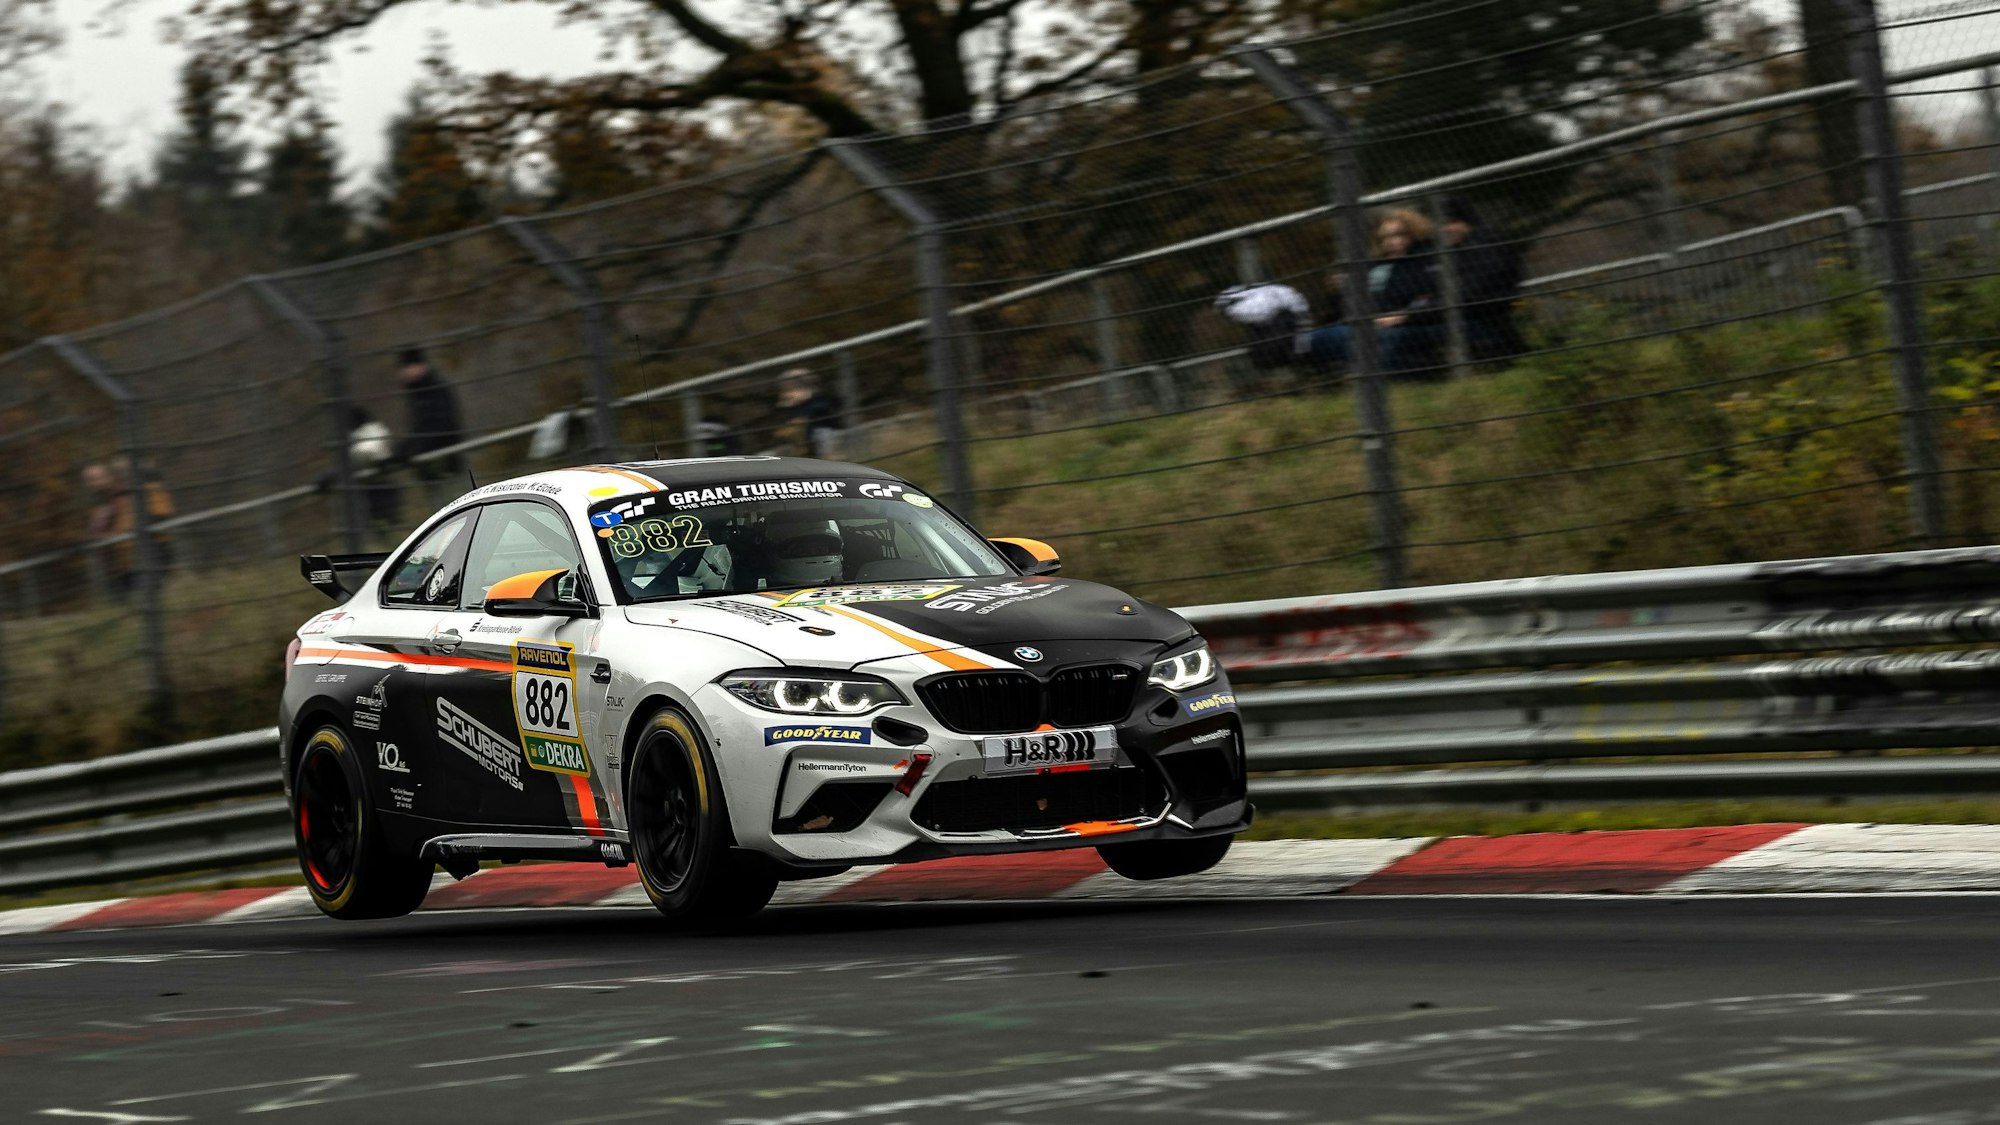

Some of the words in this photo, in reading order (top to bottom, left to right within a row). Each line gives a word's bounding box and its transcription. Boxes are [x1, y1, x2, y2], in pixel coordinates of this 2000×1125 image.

[668, 486, 732, 506] GRAN
[675, 503, 700, 511] THE
[701, 499, 731, 508] REAL
[731, 495, 779, 504] DRIVING
[779, 492, 843, 500] SIMULATOR
[609, 515, 713, 558] 882
[520, 647, 567, 666] RAVENOL
[525, 678, 570, 731] 882
[436, 696, 522, 777] SCHUBERT
[772, 728, 862, 740] GOODYEAR
[544, 741, 586, 770] DEKRA
[798, 762, 867, 773] HellermannTyton
[478, 754, 521, 790] MOTORS
